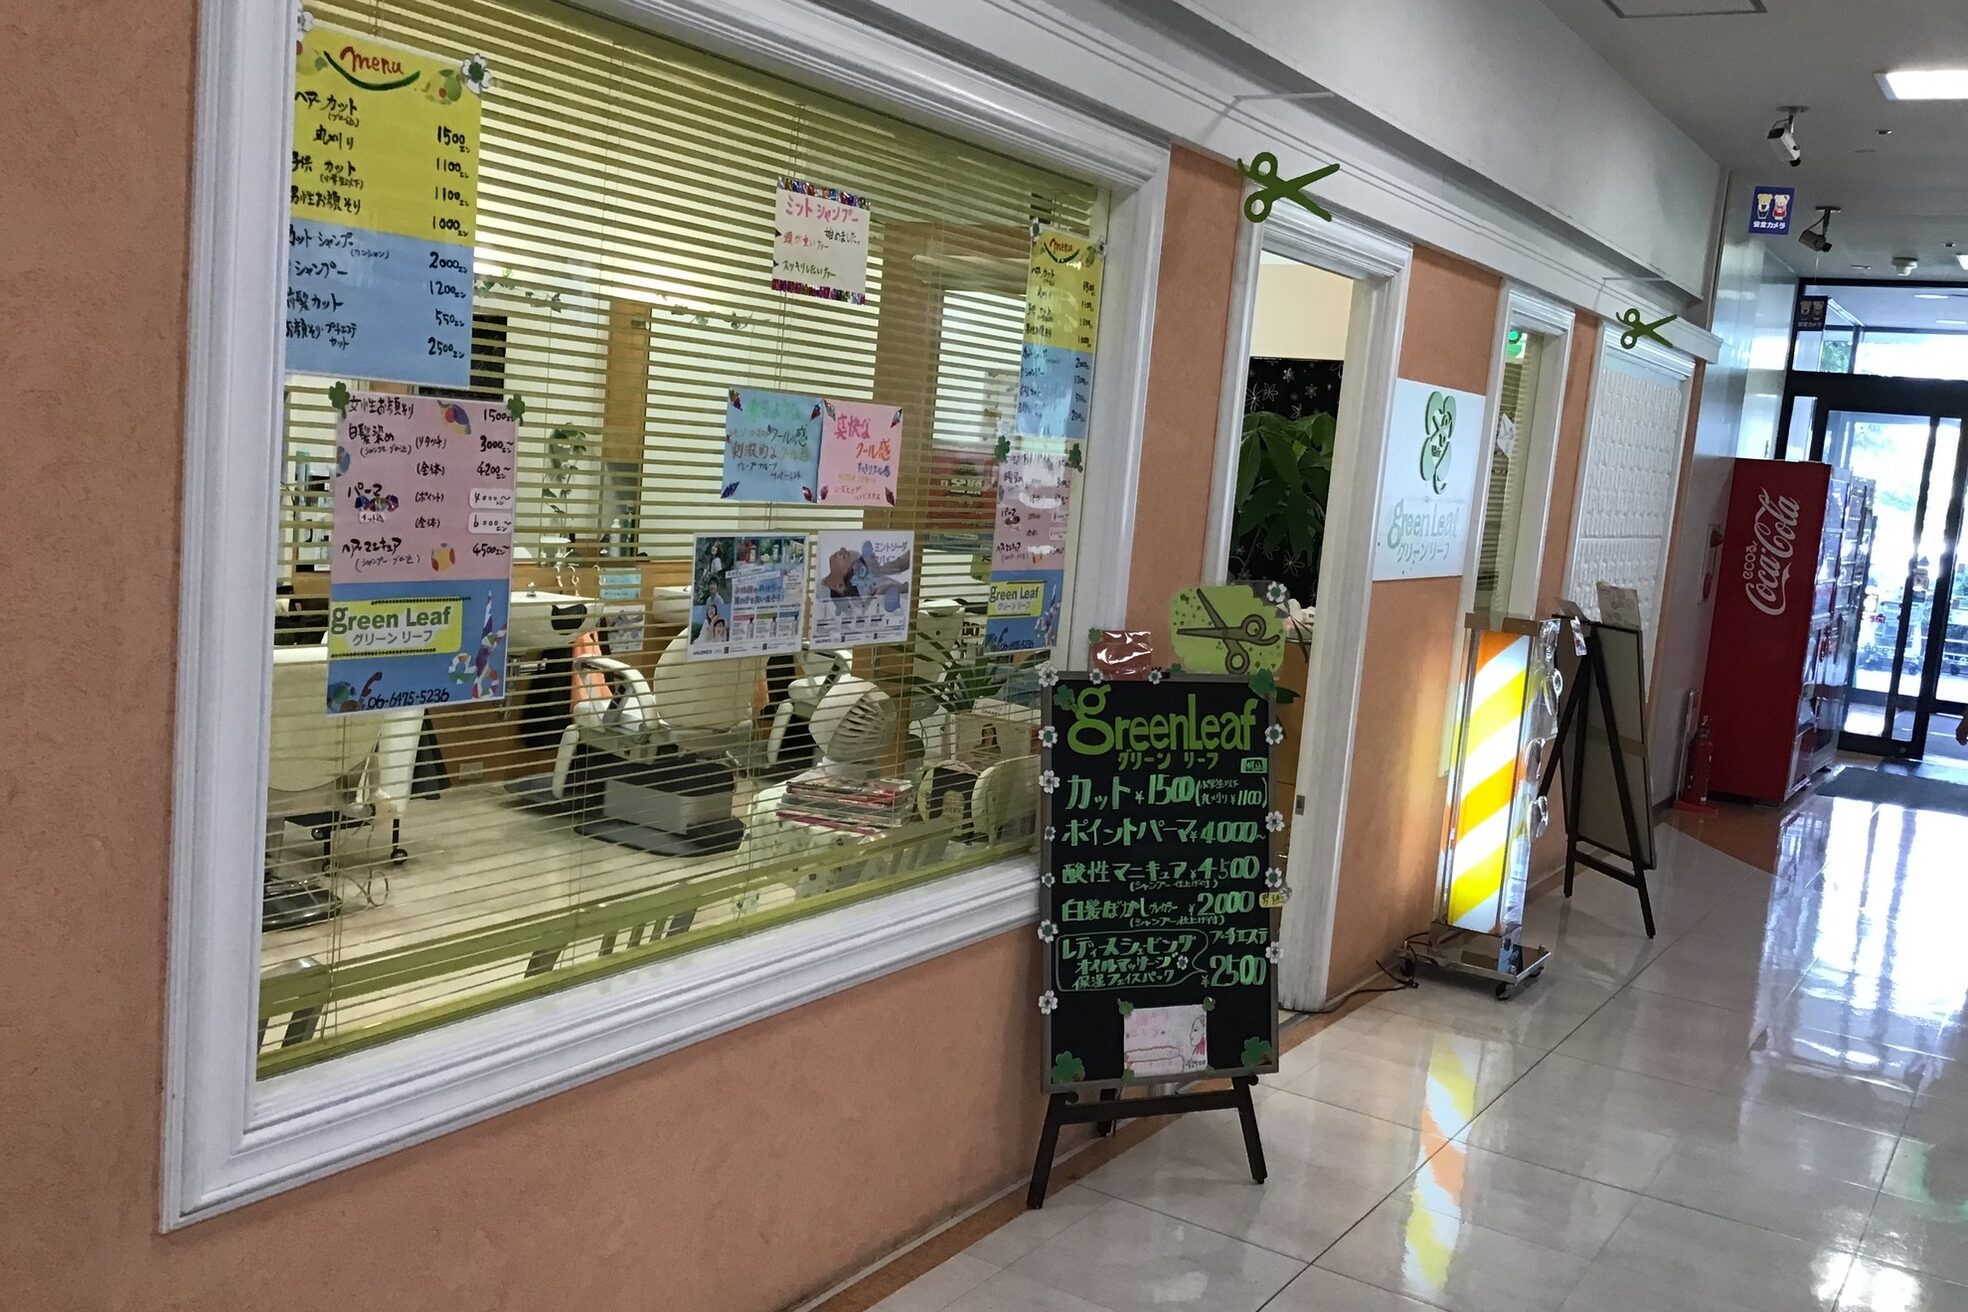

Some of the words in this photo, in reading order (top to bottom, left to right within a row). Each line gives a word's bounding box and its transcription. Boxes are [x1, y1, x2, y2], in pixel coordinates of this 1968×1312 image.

[340, 46, 404, 75] menu
[321, 95, 357, 116] カット
[313, 125, 354, 150] 丸刈り
[324, 160, 356, 177] カット
[785, 195, 813, 218] ミント
[349, 423, 395, 444] 白髪染め
[348, 482, 383, 498] パーマ
[989, 586, 1017, 603] green
[1020, 587, 1040, 600] Leaf
[330, 606, 399, 635] green
[406, 606, 452, 627] Leaf
[352, 633, 398, 647] グリーン
[402, 630, 433, 646] リーフ
[1117, 750, 1171, 772] グリーン
[1184, 751, 1219, 770] リーフ
[1065, 774, 1131, 810] カット
[1061, 818, 1198, 847] ポイントパーマ
[1062, 860, 1188, 885] 酸性マニキュア
[1190, 855, 1261, 880] ¥4500
[1061, 897, 1150, 923] 白髪ぼかし
[1209, 927, 1269, 946] プチエステ
[1075, 951, 1179, 976] オイルマッサージ
